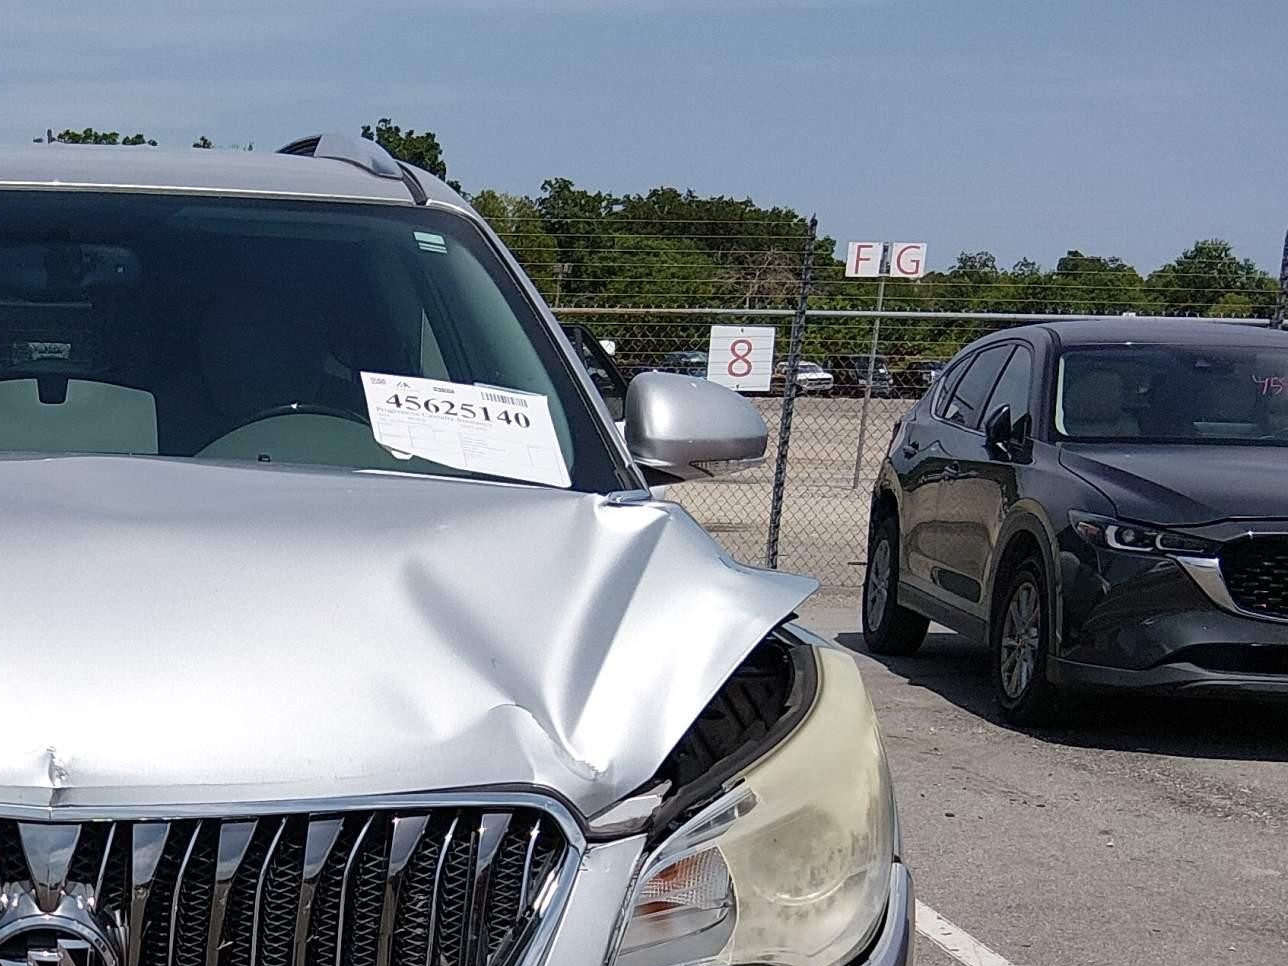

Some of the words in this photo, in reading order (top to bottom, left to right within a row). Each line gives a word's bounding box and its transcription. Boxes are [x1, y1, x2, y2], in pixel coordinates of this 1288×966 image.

[854, 244, 873, 275] F
[896, 245, 921, 275] G
[727, 339, 753, 377] 8
[385, 393, 531, 429] 45625140
